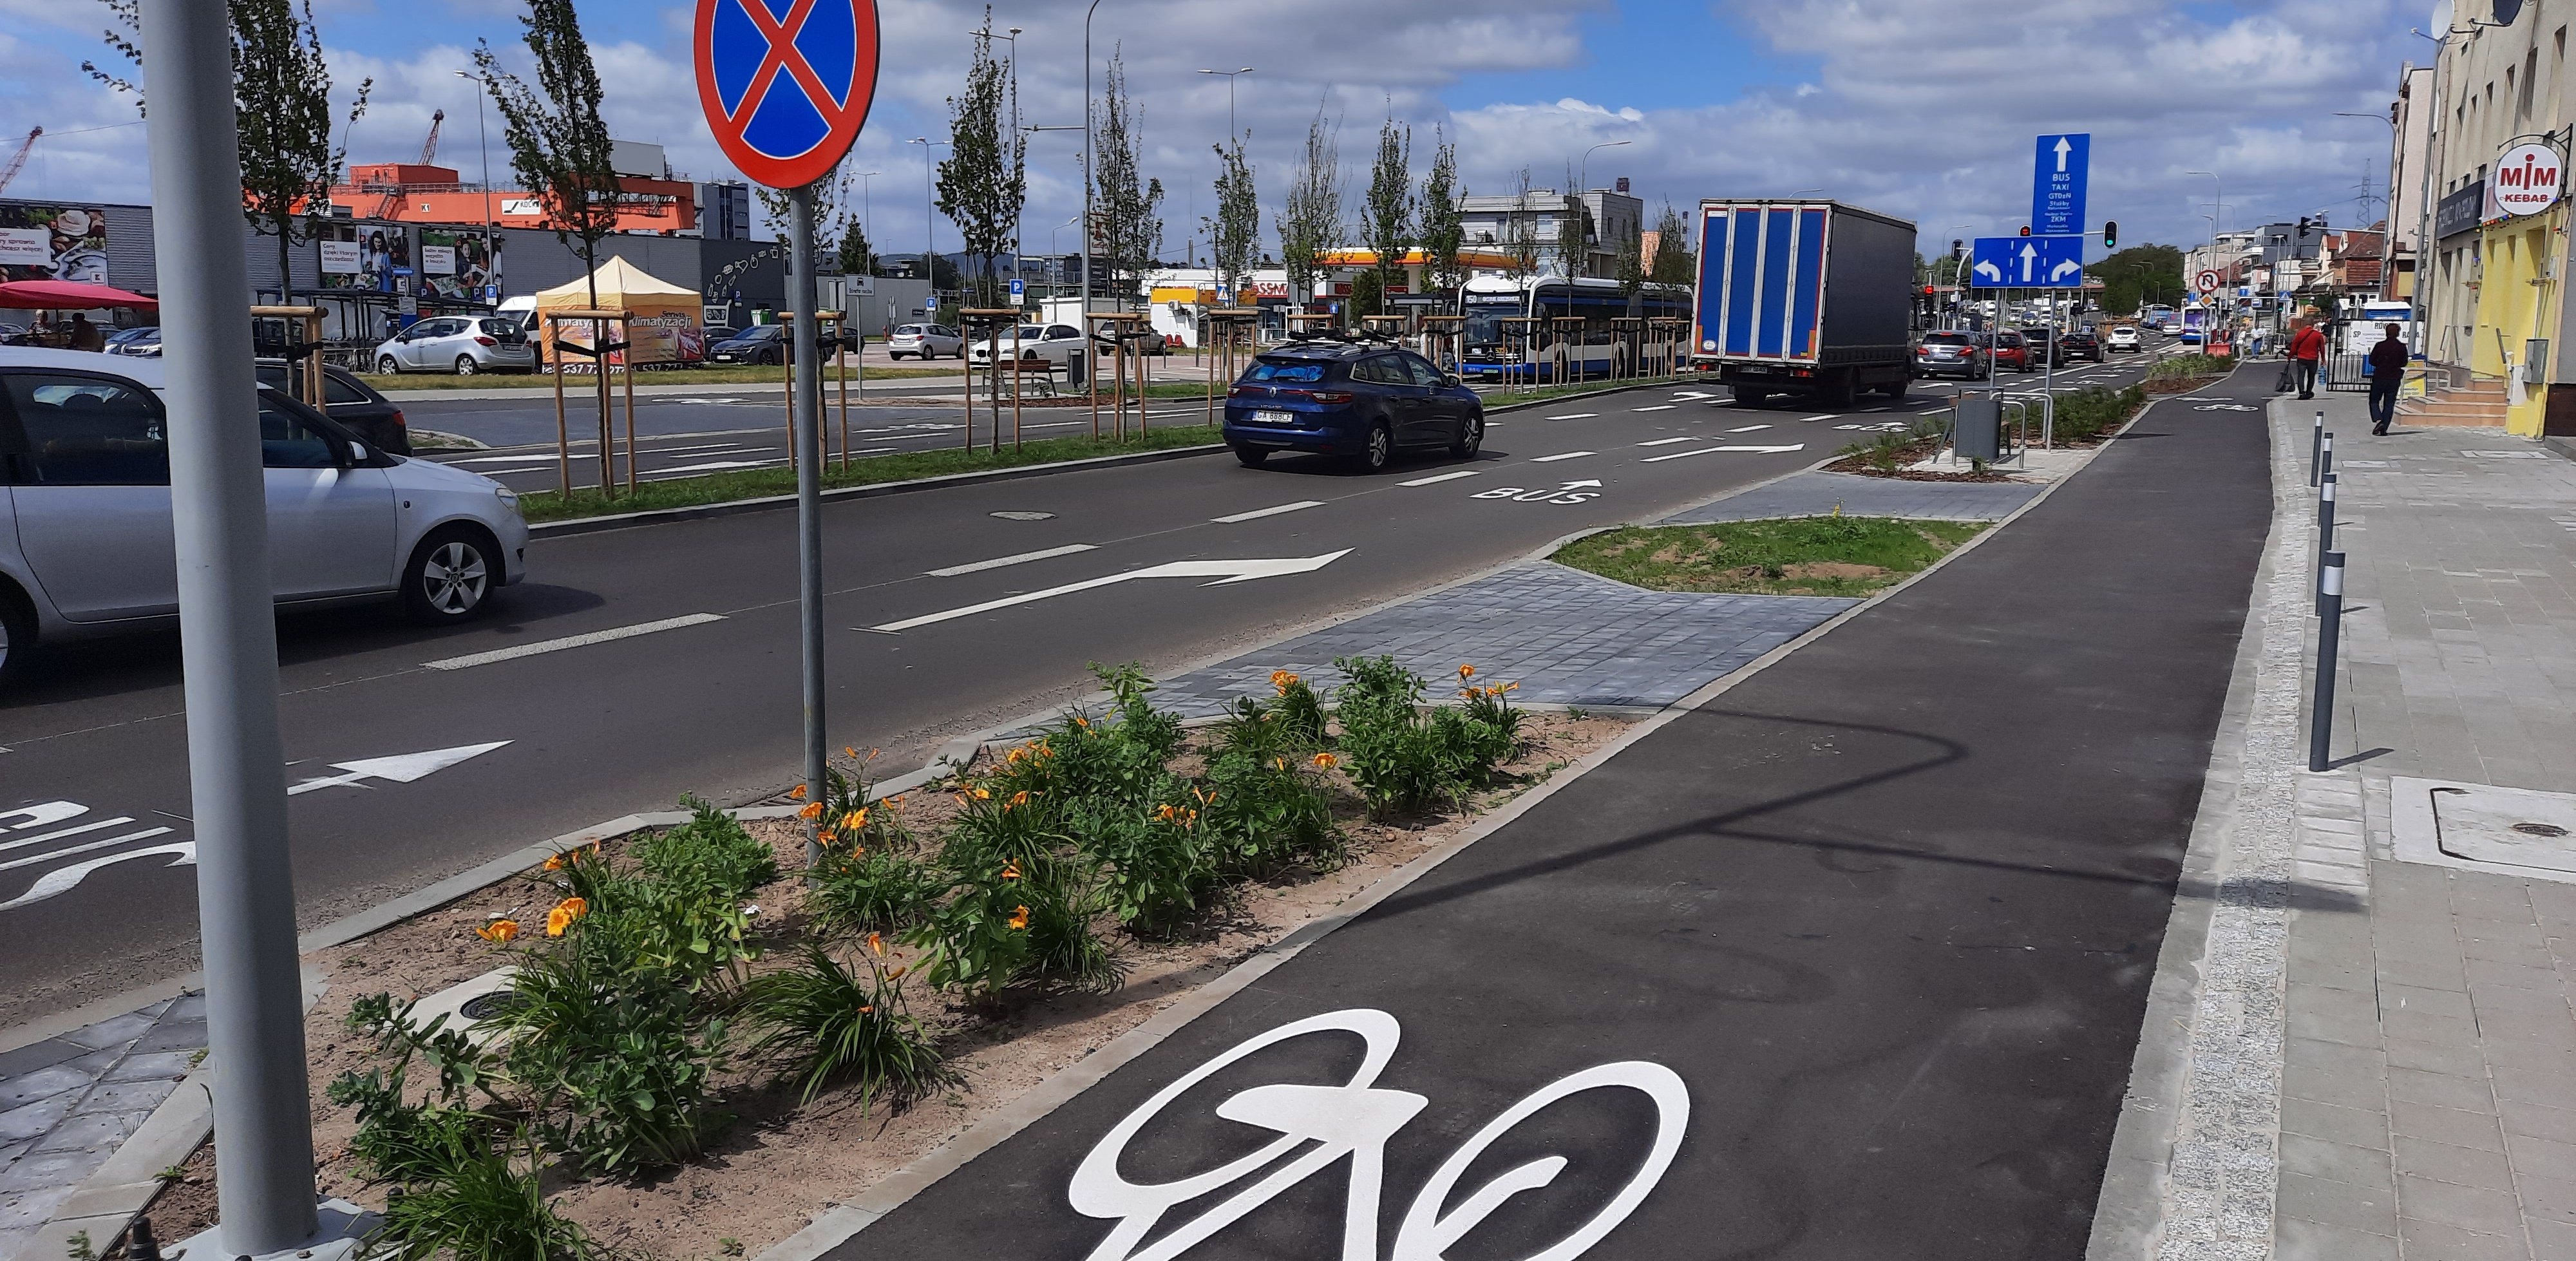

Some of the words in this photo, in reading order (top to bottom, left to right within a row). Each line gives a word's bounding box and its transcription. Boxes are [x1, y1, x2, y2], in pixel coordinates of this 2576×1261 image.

[2505, 194, 2548, 202] KEBAB
[629, 315, 692, 330] Klimatyzacji
[1469, 487, 1602, 505] BUS
